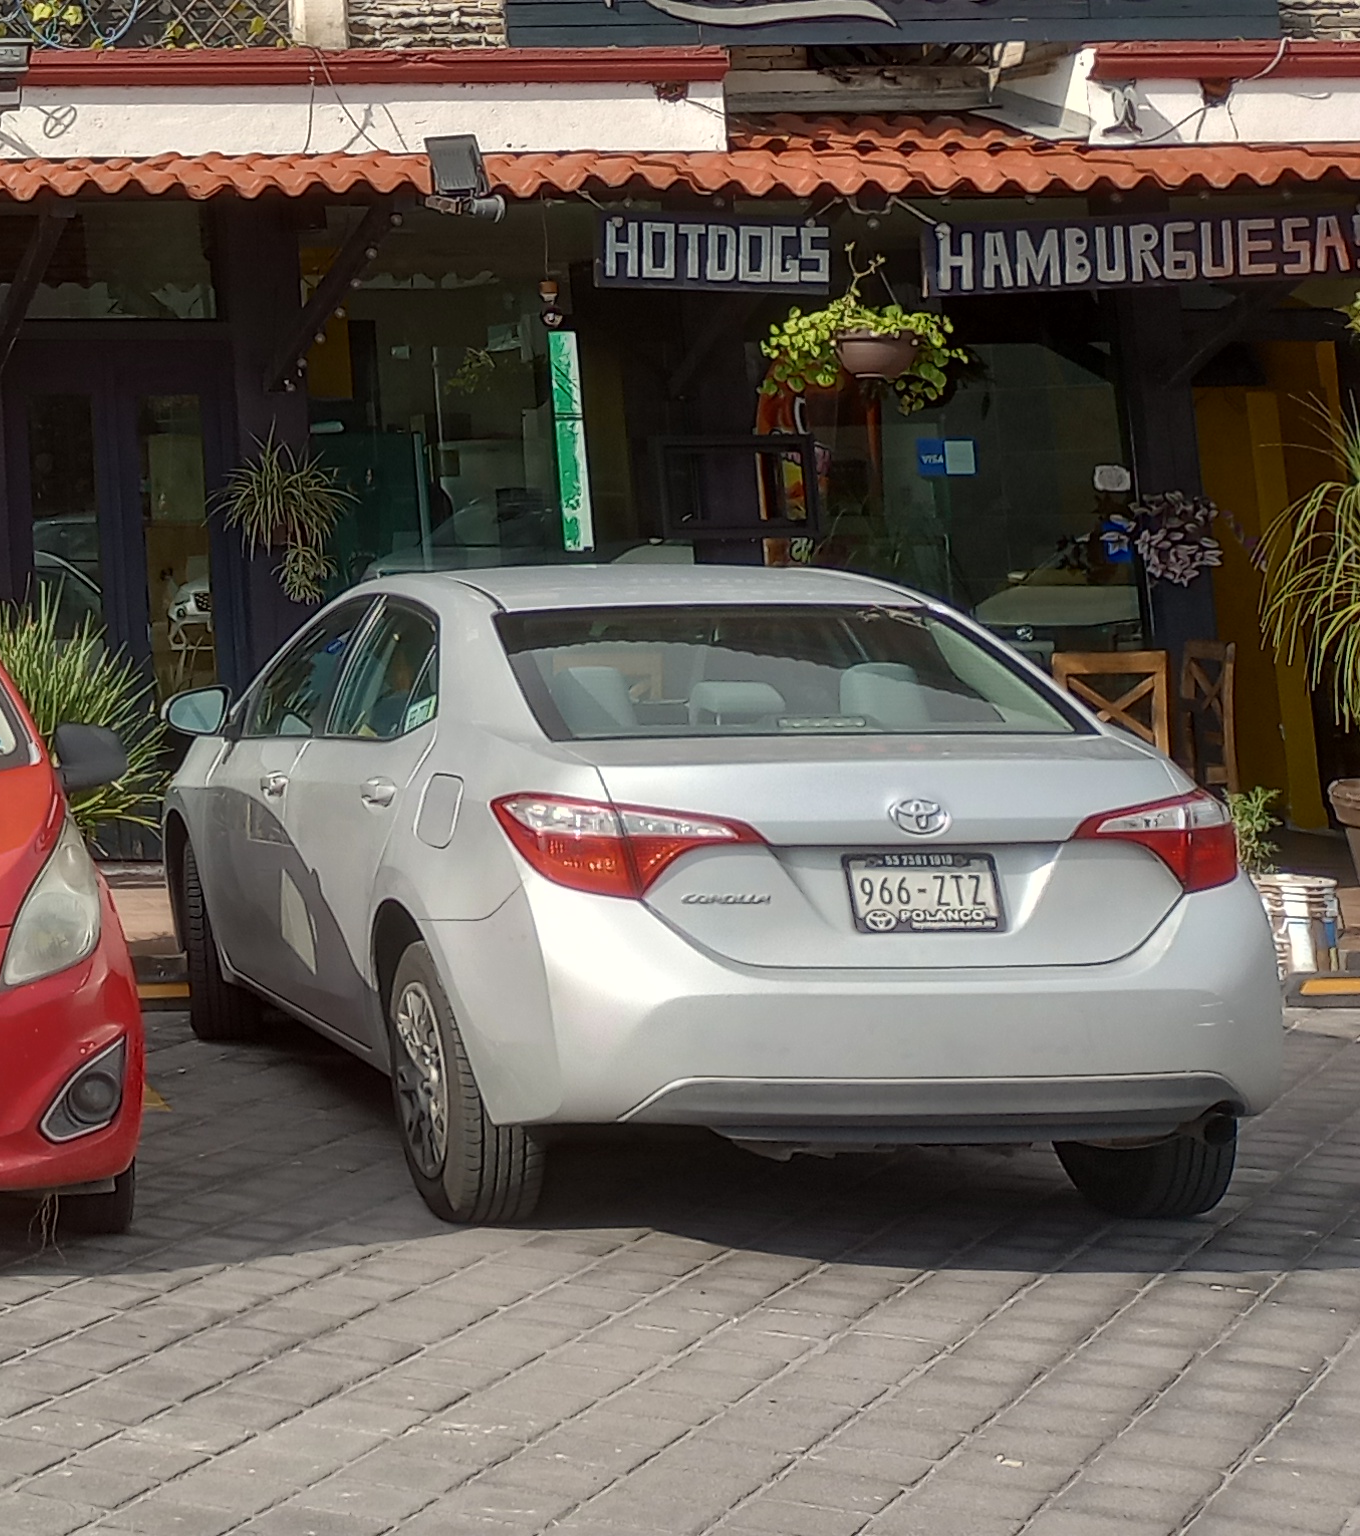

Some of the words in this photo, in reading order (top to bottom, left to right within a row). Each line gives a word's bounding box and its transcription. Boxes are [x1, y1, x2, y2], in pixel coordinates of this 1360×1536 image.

[605, 214, 830, 287] HOTDOGS
[921, 454, 944, 465] VISA
[860, 874, 986, 906] 966-ZTZ
[900, 909, 986, 921] POLANCO
